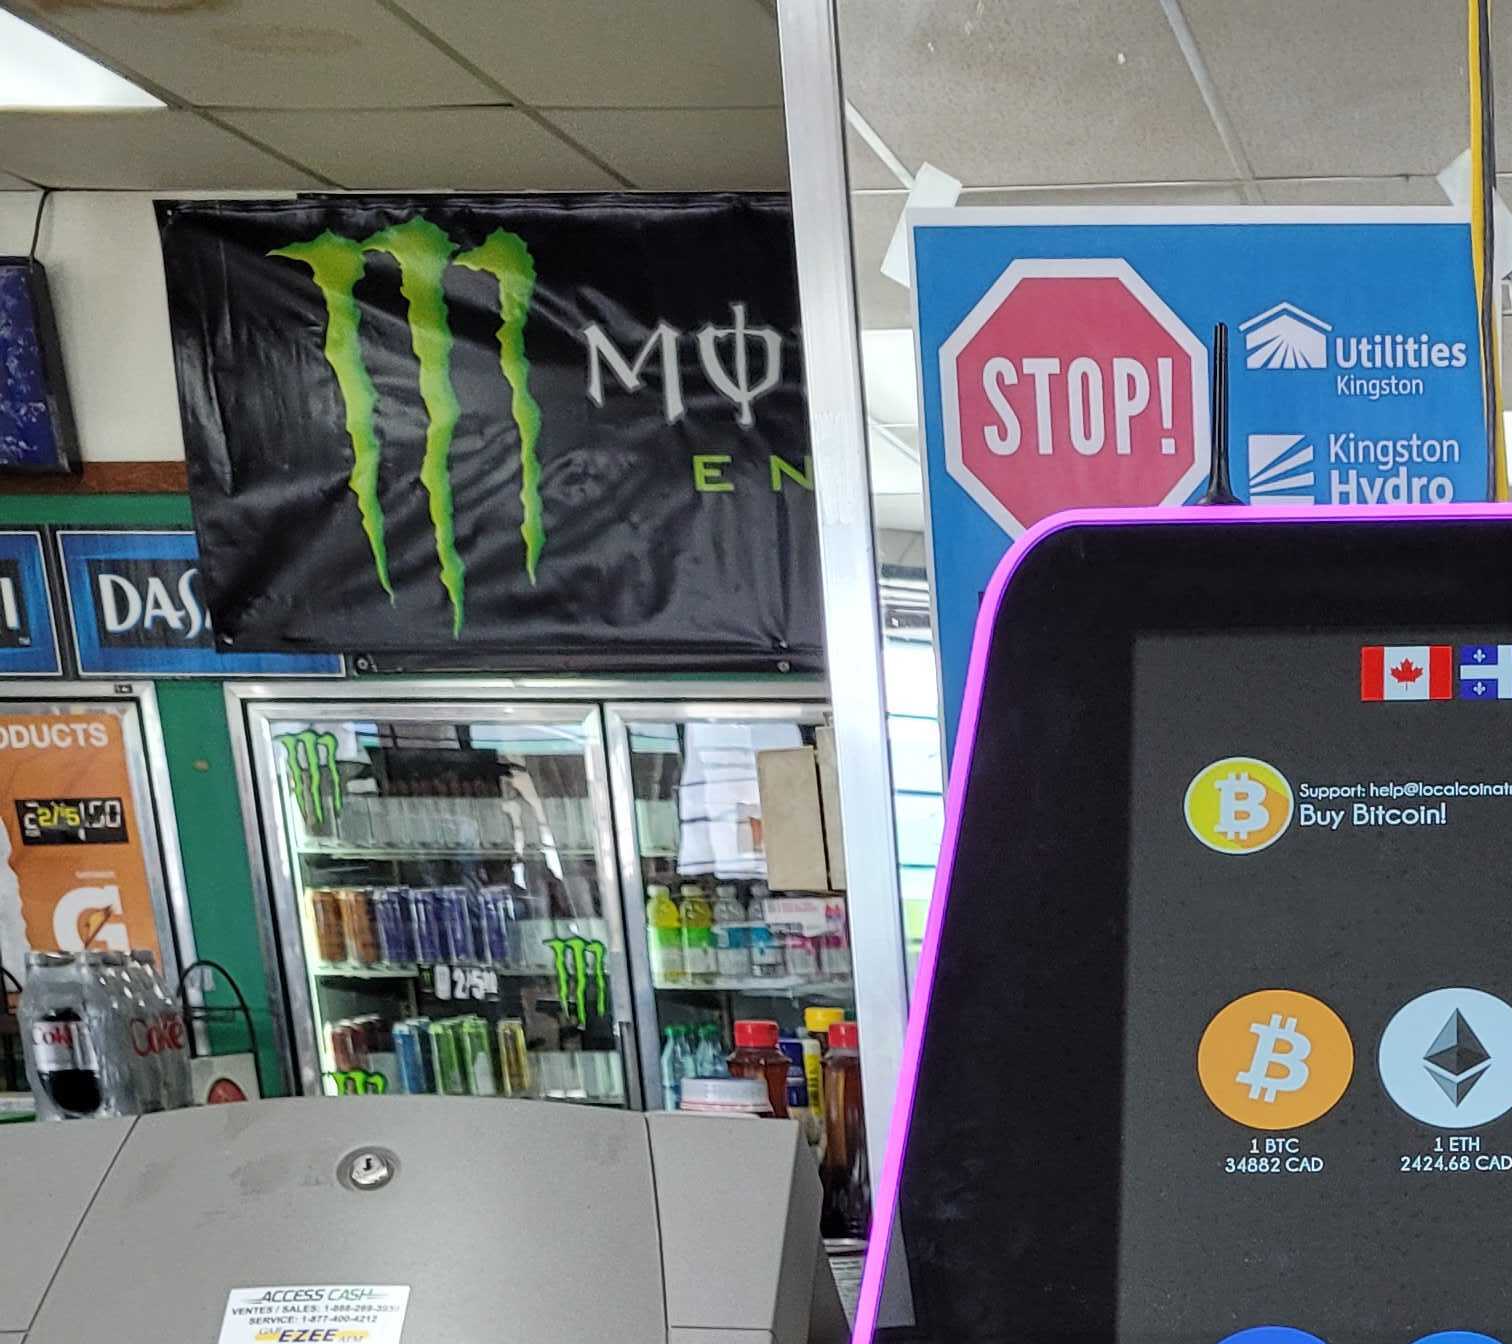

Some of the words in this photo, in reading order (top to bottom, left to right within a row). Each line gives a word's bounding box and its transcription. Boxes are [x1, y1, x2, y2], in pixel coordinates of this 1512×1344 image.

[1336, 335, 1468, 369] Utilities
[1337, 375, 1424, 400] Kingston
[982, 357, 1177, 456] STOP!
[1329, 433, 1461, 472] Kingston
[1331, 469, 1455, 505] Hydro
[1299, 783, 1366, 800] Support:
[1300, 803, 1344, 829] Buy
[1353, 802, 1447, 825] Bitcoin!
[1249, 1138, 1260, 1153] 1
[1265, 1138, 1300, 1153] BTC
[1433, 1136, 1444, 1152] 1
[1449, 1136, 1480, 1152] ETH
[1224, 1157, 1281, 1173] 34882
[1285, 1156, 1325, 1172] CAD
[1400, 1155, 1471, 1173] 2424.68
[261, 1288, 325, 1303] ACCESS
[327, 1287, 374, 1301] CASH
[232, 1305, 274, 1316] VENTES
[281, 1305, 320, 1314] SALES:
[249, 1316, 297, 1326] SERVICE:
[278, 1329, 339, 1343] EZEE
